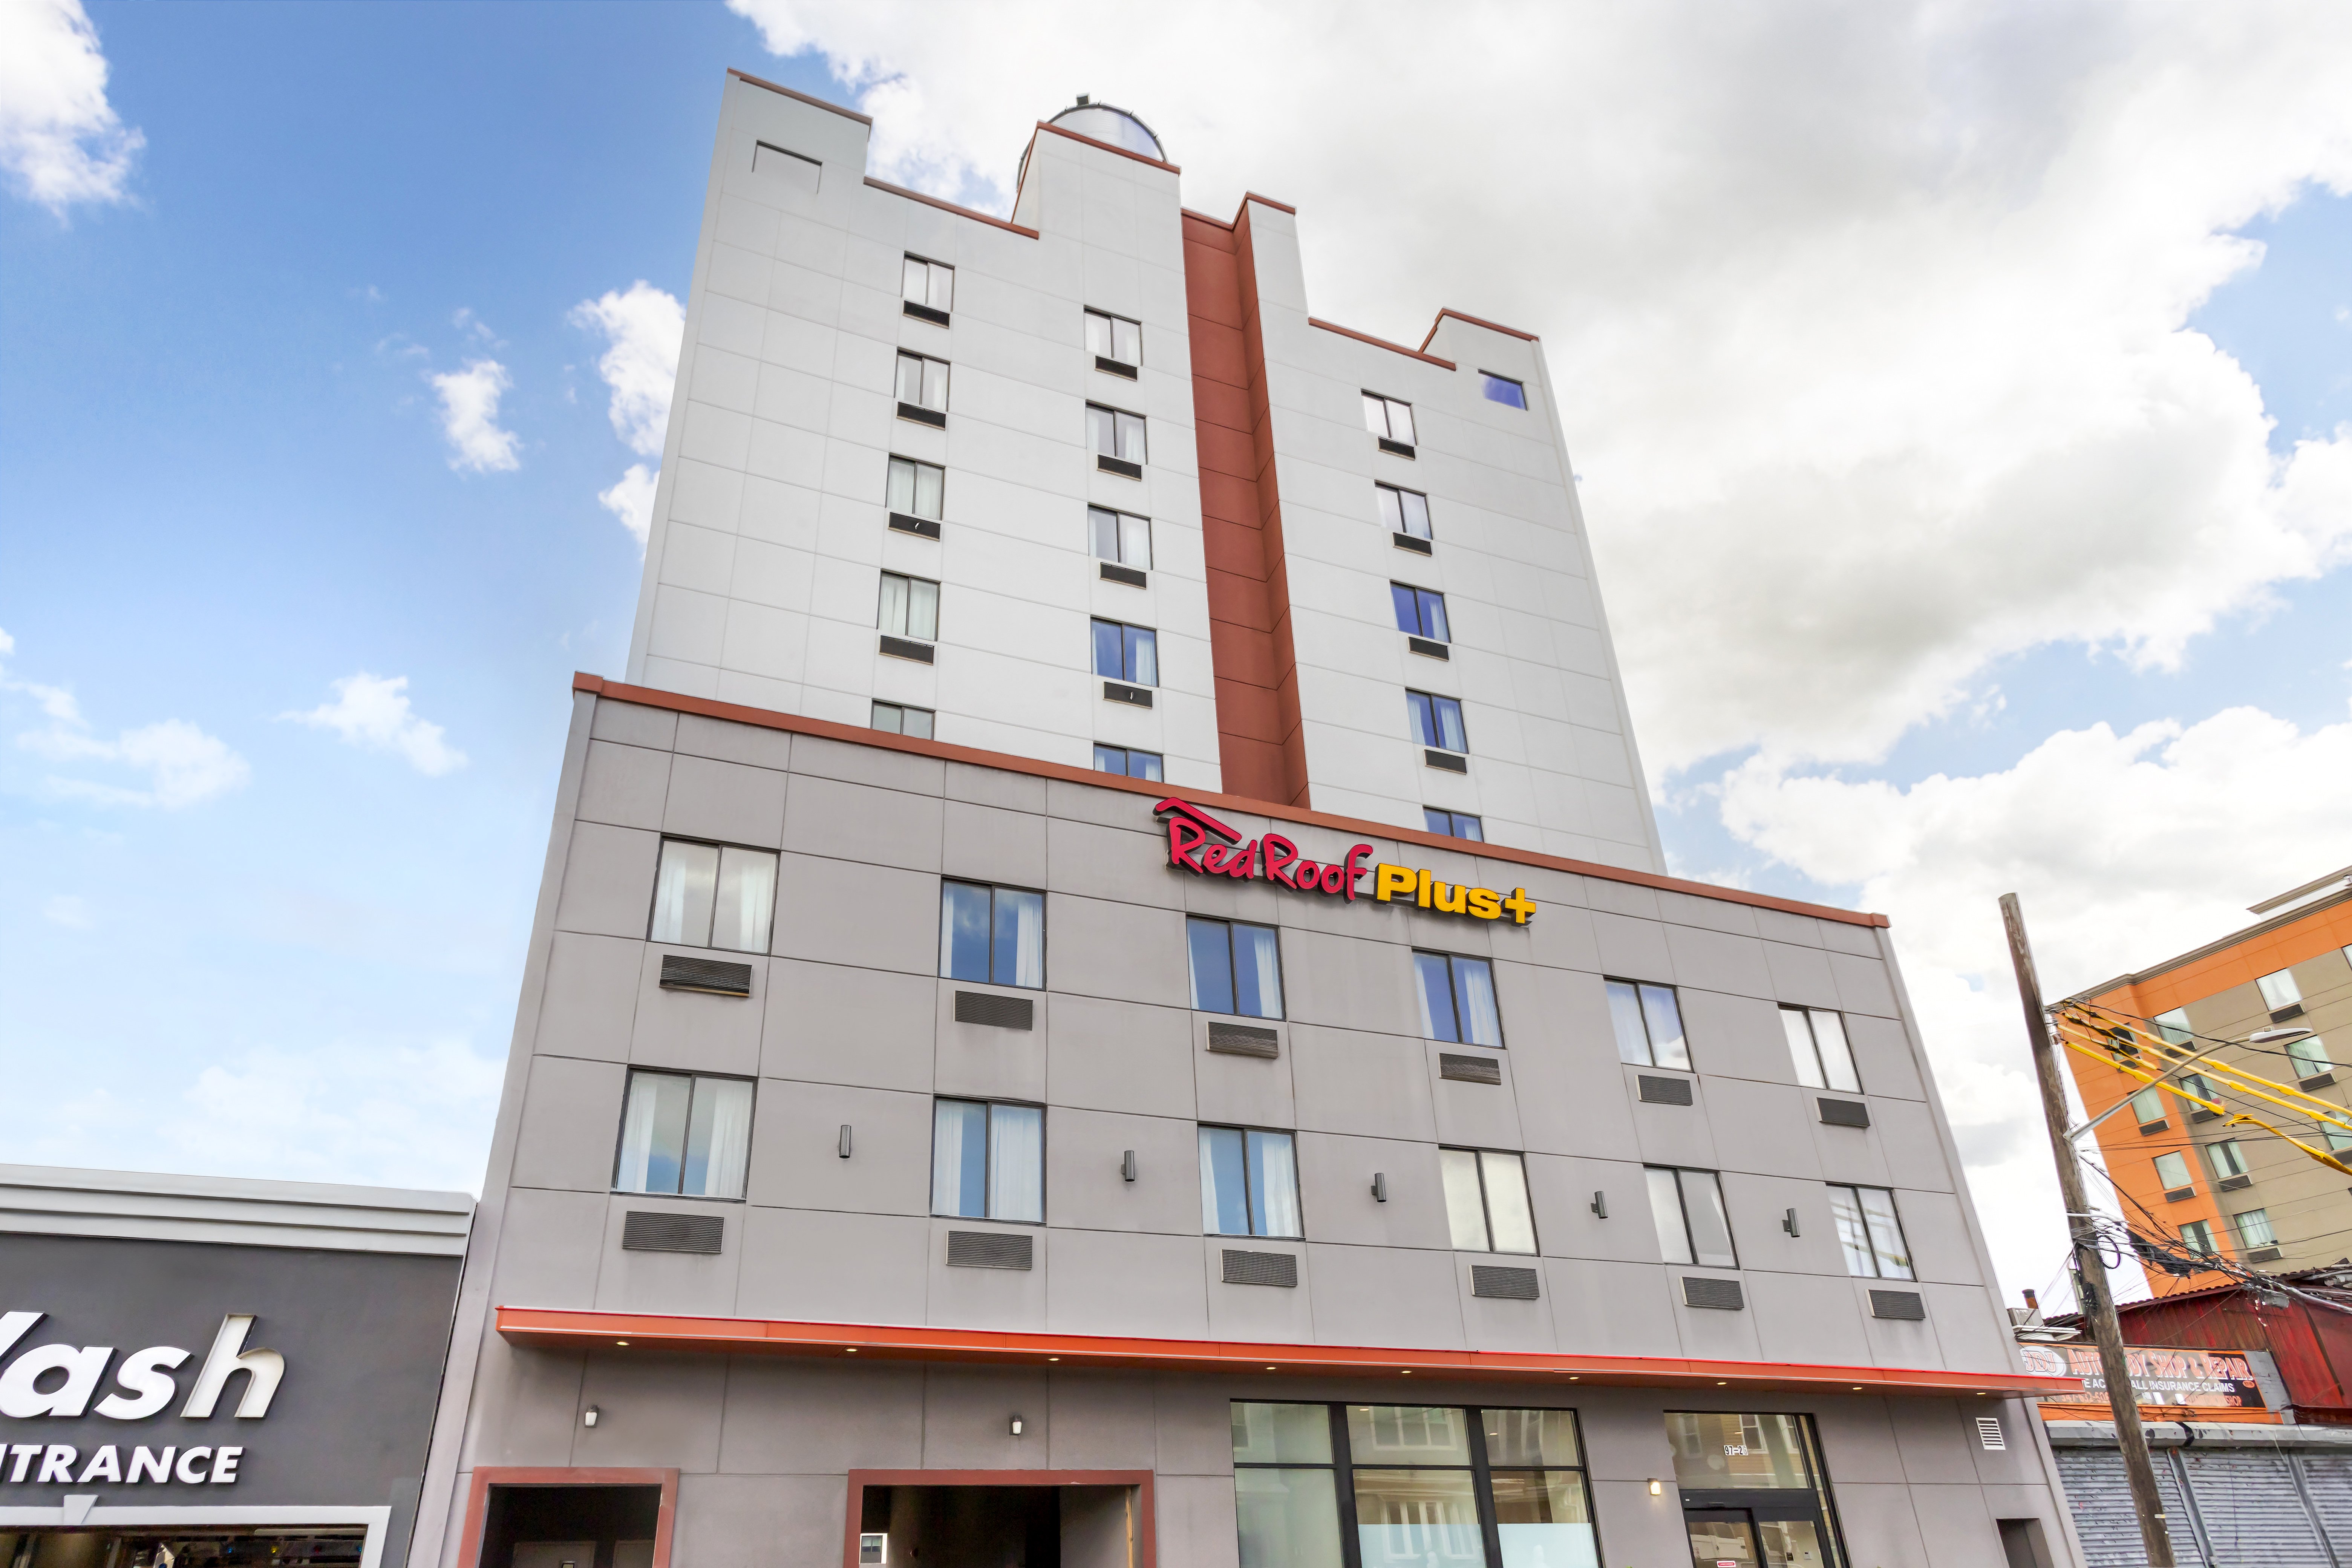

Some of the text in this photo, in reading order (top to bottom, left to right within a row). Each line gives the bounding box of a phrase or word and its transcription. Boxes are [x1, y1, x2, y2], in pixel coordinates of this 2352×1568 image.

[1375, 863, 1536, 924] Plus+
[2022, 1351, 2057, 1372] JDJ
[2125, 1353, 2150, 1378] DY
[2148, 1352, 2187, 1378] SHOP
[2188, 1357, 2205, 1379] &
[2199, 1353, 2254, 1381] REPAIR
[2130, 1380, 2149, 1390] ALL
[2149, 1380, 2201, 1392] INSURANCE
[2203, 1383, 2236, 1393] CLAIMS
[1724, 1446, 1747, 1455] 97-26
